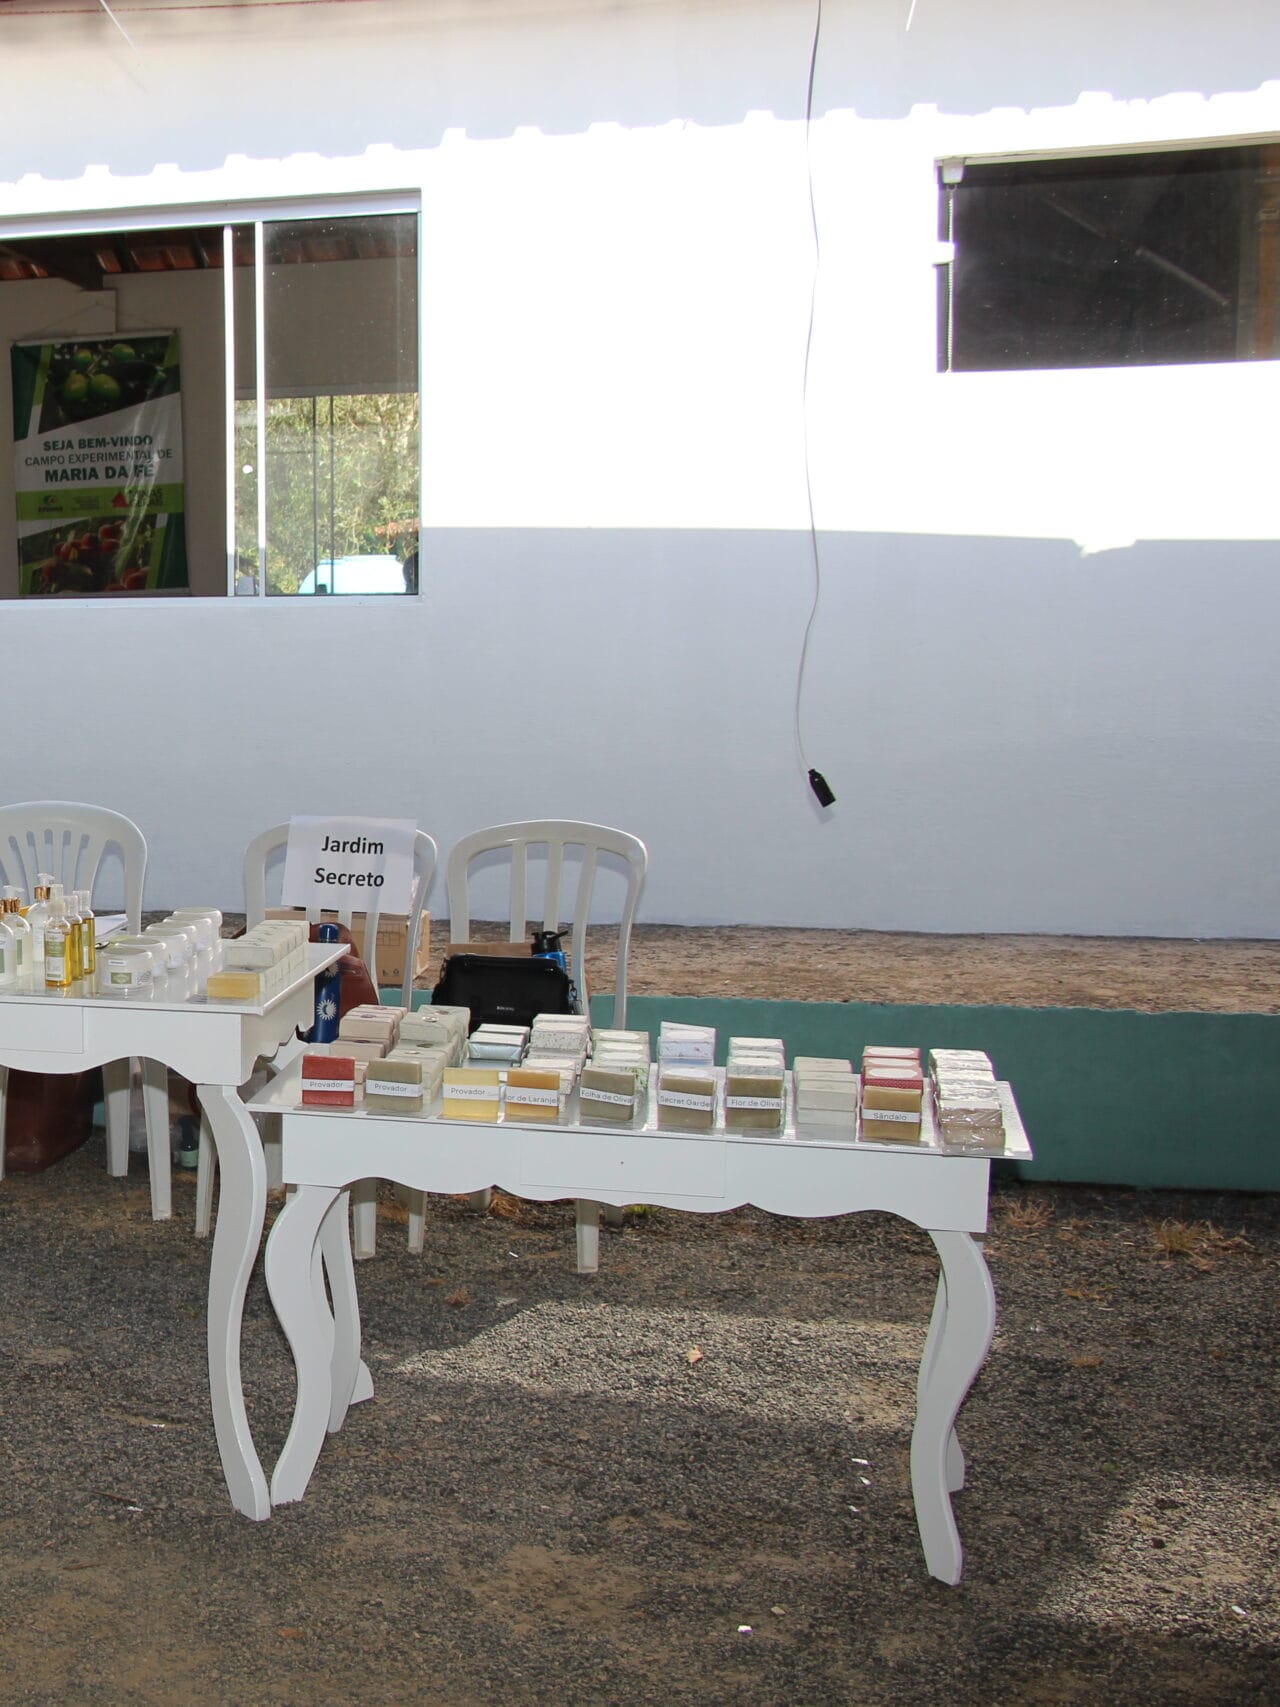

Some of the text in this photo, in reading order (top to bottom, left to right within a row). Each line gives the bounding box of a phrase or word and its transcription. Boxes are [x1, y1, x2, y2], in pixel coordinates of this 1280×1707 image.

[43, 435, 153, 451] SEJA BEM-VINDO
[25, 448, 173, 466] CAMPO EXPERIMENTAL DE
[45, 466, 99, 482] MARIA
[105, 465, 128, 479] DA
[321, 836, 384, 855] Jardim
[314, 867, 384, 887] Secreto
[309, 1080, 344, 1089] Provador
[374, 1083, 407, 1093] Provador
[450, 1087, 485, 1096] Provador
[582, 1089, 601, 1099] Folha
[731, 1098, 746, 1106] Flor
[747, 1098, 758, 1106] de
